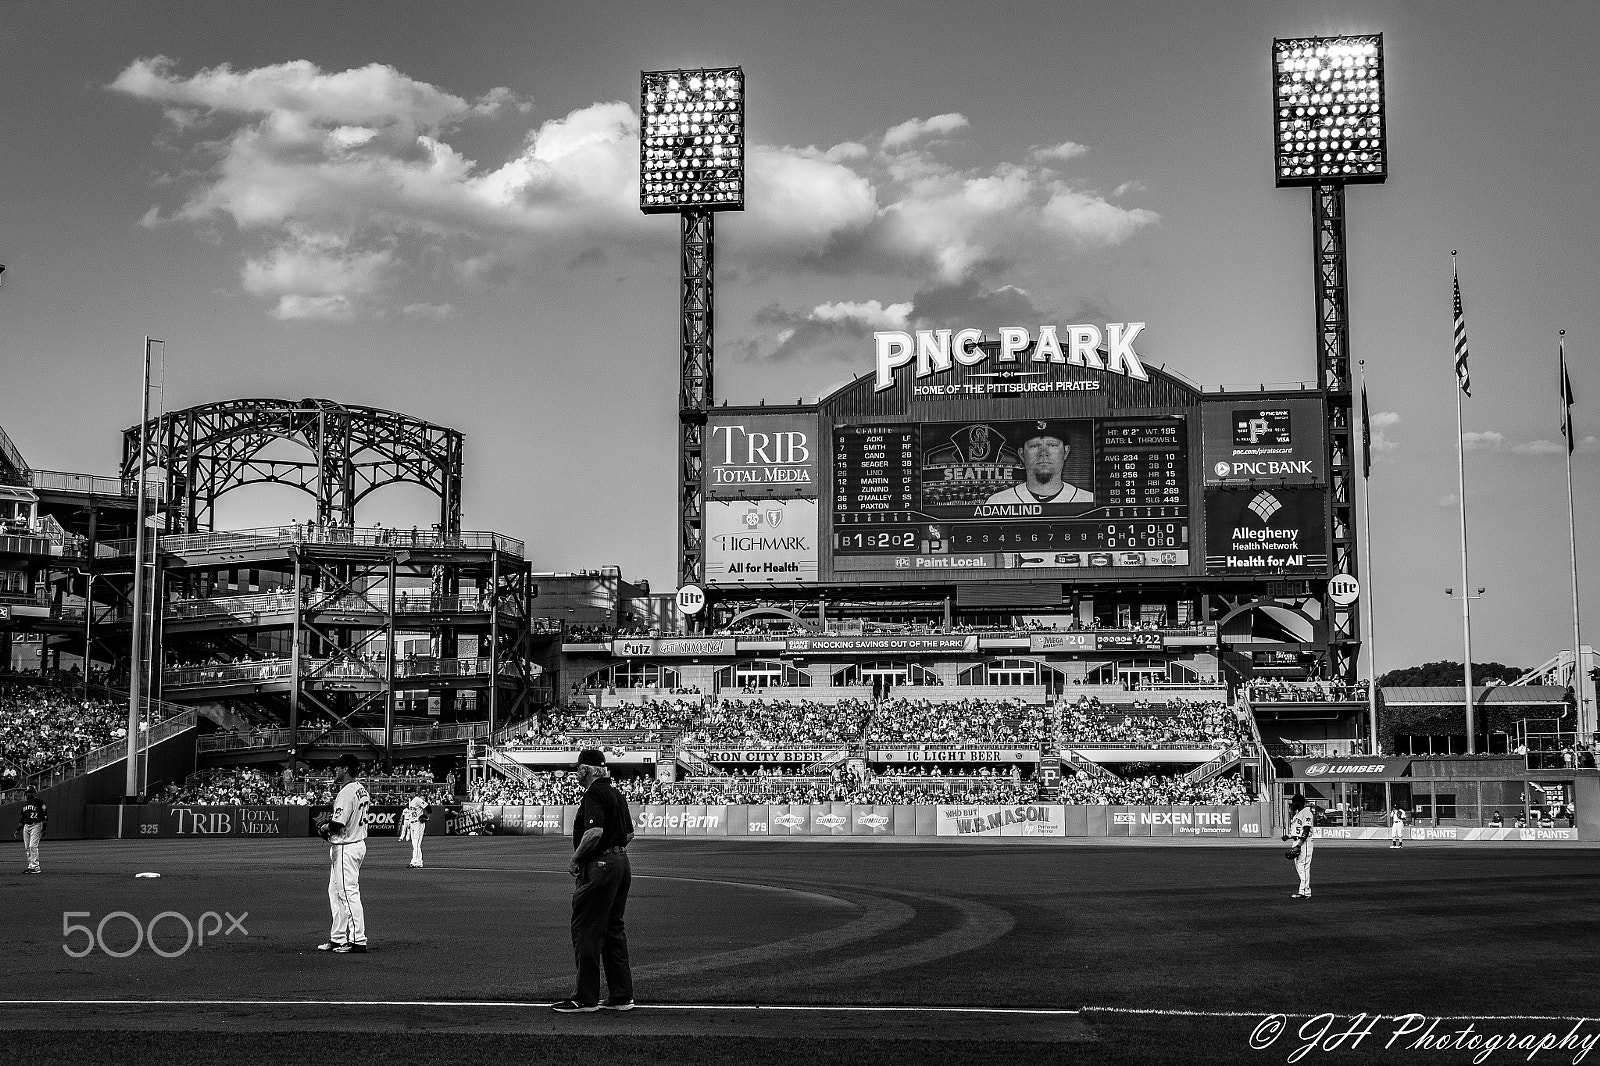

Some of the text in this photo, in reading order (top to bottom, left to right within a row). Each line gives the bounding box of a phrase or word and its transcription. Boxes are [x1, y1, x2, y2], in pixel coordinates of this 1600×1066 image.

[873, 322, 1149, 394] PNC PARK
[914, 380, 1100, 396] HOME OF THE PITTSBURGH PIRATES
[1160, 427, 1176, 435] 195
[866, 435, 883, 443] AOKI
[1105, 437, 1126, 445] BATS:
[712, 425, 810, 465] TRIB
[1121, 454, 1139, 462] .234
[861, 460, 889, 468] SEAGER
[1231, 460, 1313, 475] PNC BANK
[712, 467, 811, 483] TOTAL MEDIA
[944, 467, 1014, 480] SEATTLE
[1122, 471, 1138, 479] 256
[860, 477, 889, 485] MARTIN
[1145, 496, 1160, 504] SLG
[860, 502, 890, 510] PAXTON
[1166, 523, 1174, 533] 0
[1231, 526, 1299, 542] Allegheny
[842, 536, 851, 546] B
[853, 533, 862, 548] 1
[867, 535, 876, 546] S
[878, 533, 890, 547] 2
[903, 532, 915, 547] 2
[1232, 541, 1299, 551] Health Network
[915, 557, 948, 568] Paint
[950, 556, 987, 567] Local.
[1226, 554, 1303, 568] Health for All
[728, 561, 799, 573] All for Health
[1330, 580, 1357, 597] Lite
[679, 591, 703, 607] Lite
[812, 641, 854, 649] KNOCKING
[855, 640, 889, 648] SAVINGS
[890, 640, 908, 648] OUT
[909, 640, 921, 648] OF
[939, 639, 963, 647] PARK!
[1133, 634, 1161, 644] $422
[746, 752, 780, 761] CITY
[784, 752, 823, 761] BEER
[907, 751, 1002, 761] IC LIGHT BEER
[1306, 764, 1386, 774] 84 LUMBER
[238, 808, 280, 821] TOTAL
[945, 809, 978, 819] WHO BUT
[1140, 812, 1192, 825] NEXEN
[1195, 812, 1232, 825] TIRE
[170, 808, 232, 835] TRIB
[445, 810, 494, 834] PIRATES
[140, 823, 159, 834] 325
[241, 821, 280, 834] MEDIA
[748, 822, 767, 832] 379
[1179, 827, 1200, 835] Driving
[1241, 823, 1259, 833] 410
[1323, 829, 1351, 838] PAINTS
[1427, 829, 1457, 838] PAINTS
[1537, 829, 1569, 839] PAINTS
